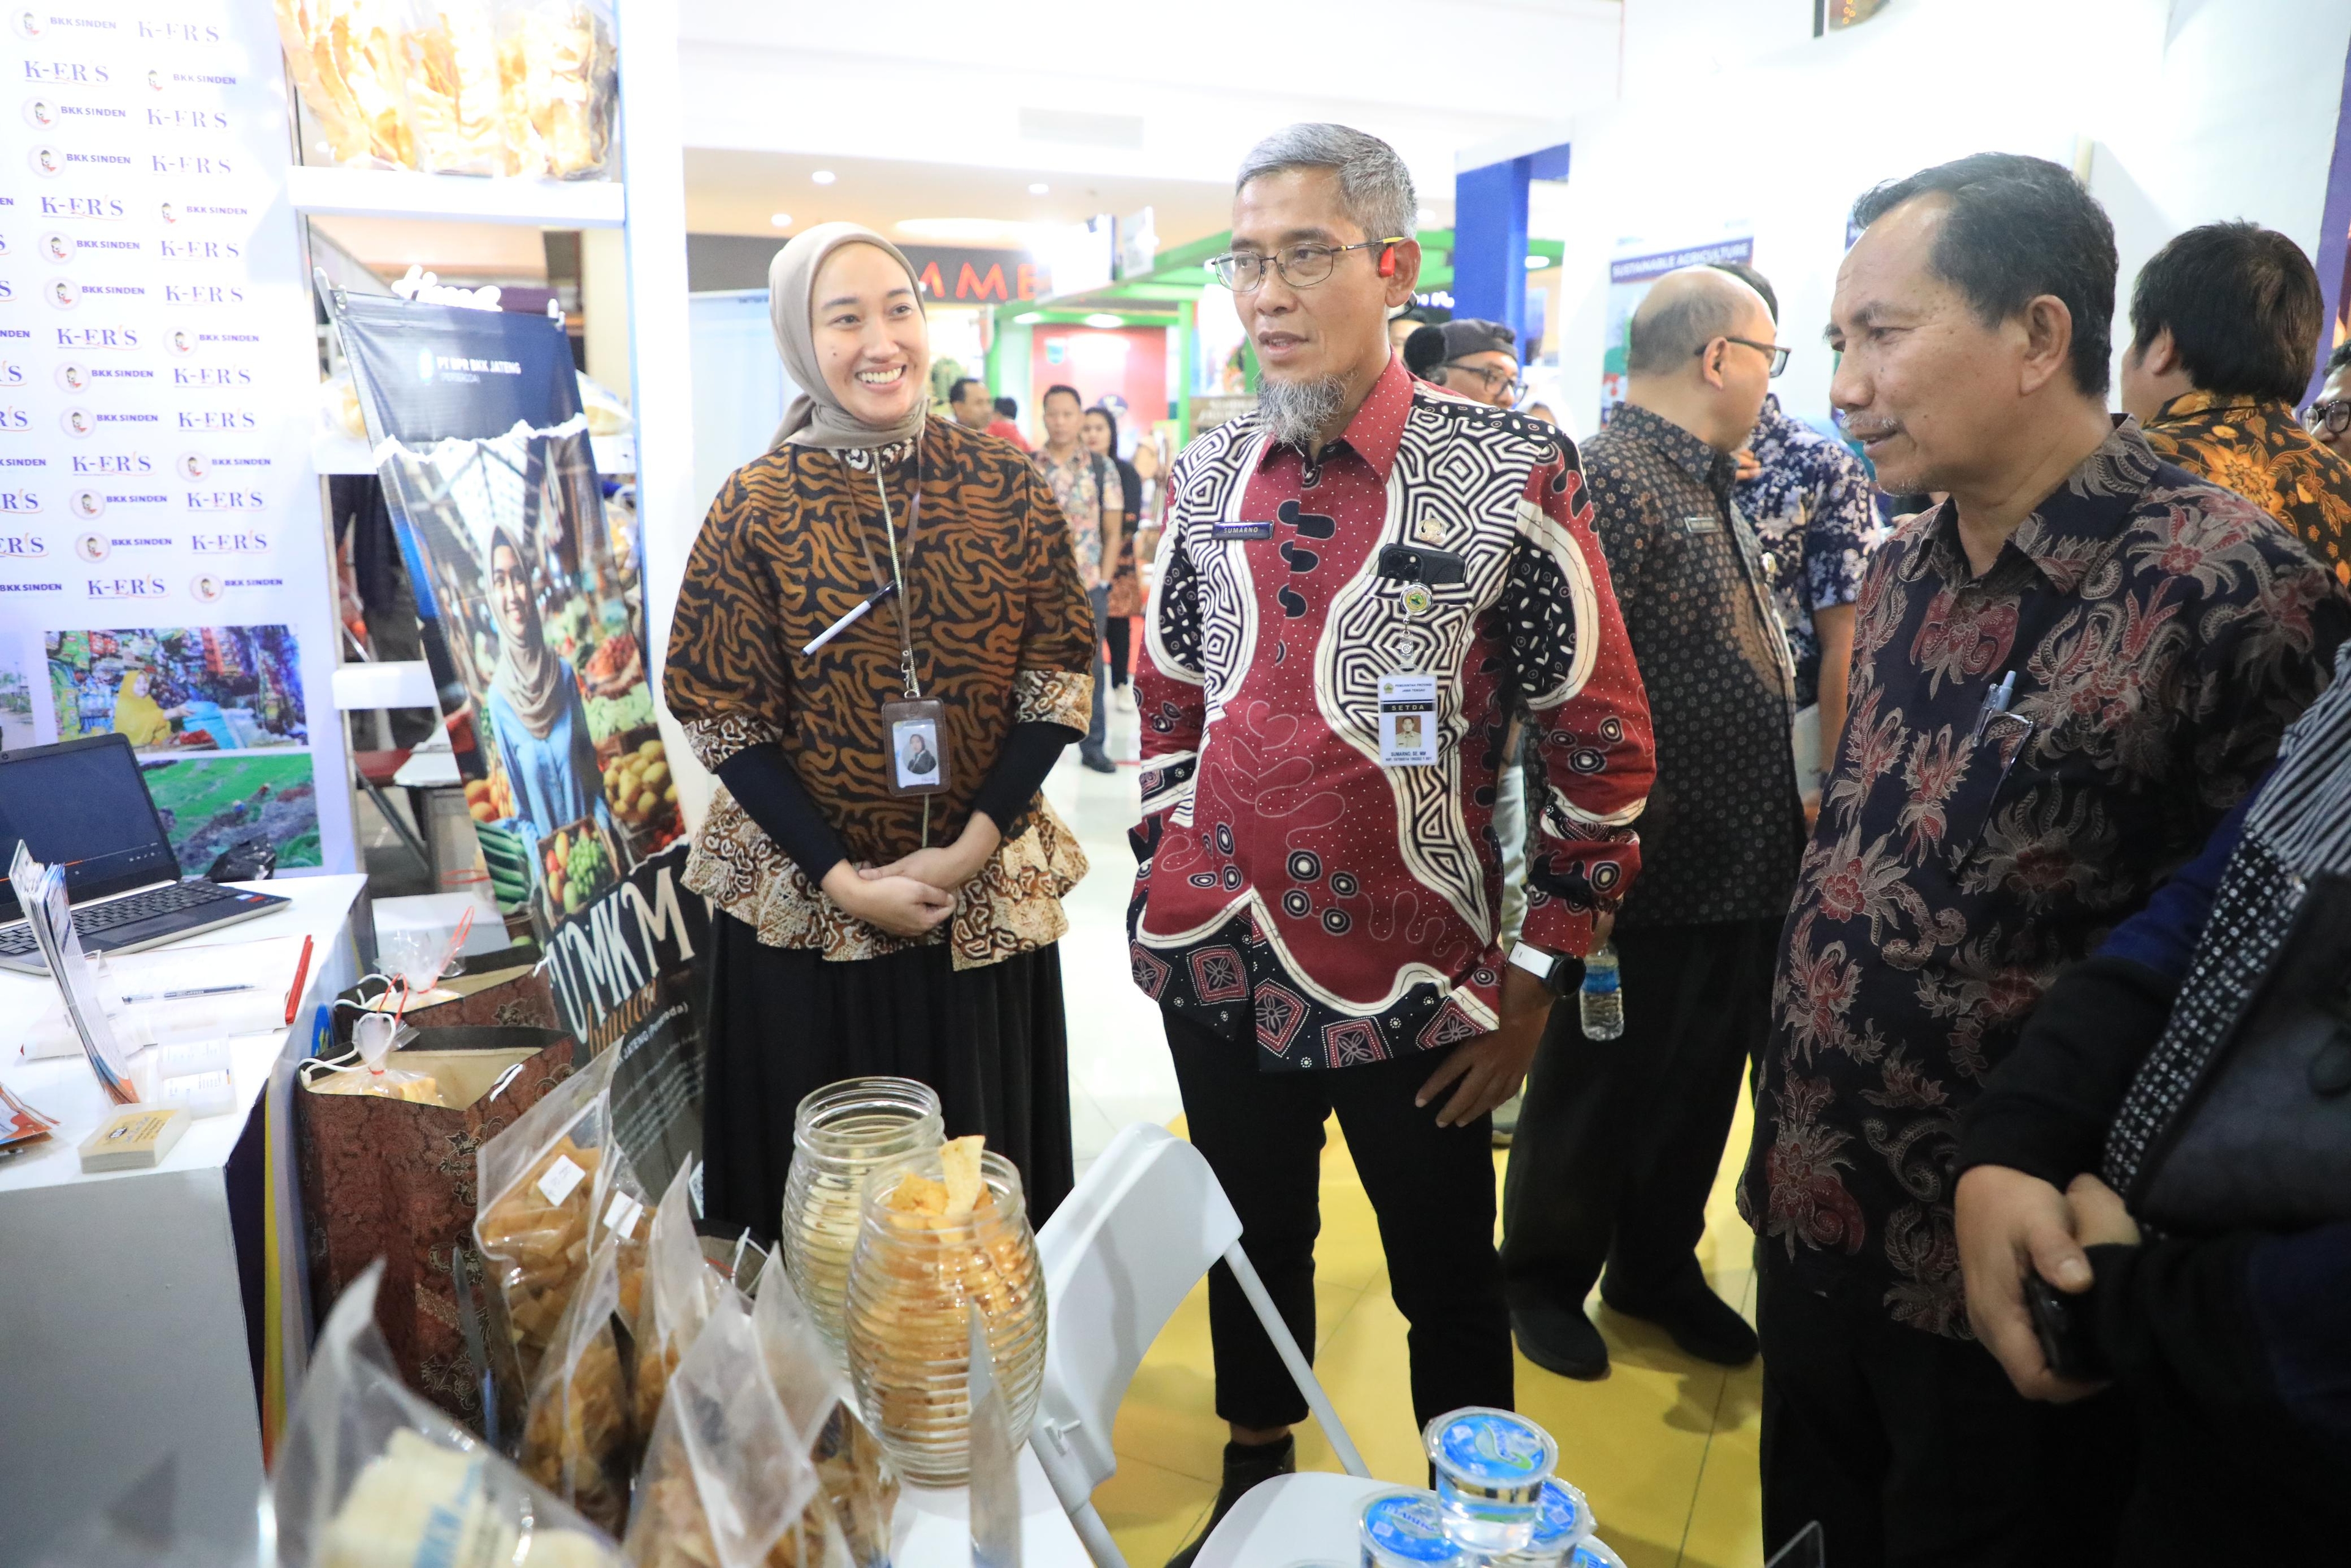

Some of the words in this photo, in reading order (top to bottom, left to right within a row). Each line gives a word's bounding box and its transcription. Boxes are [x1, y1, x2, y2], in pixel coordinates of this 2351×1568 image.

[50, 17, 73, 26] BKK
[75, 18, 116, 29] SINDEN
[173, 73, 195, 82] BKK
[197, 75, 236, 85] SINDEN
[61, 107, 83, 116] BKK
[85, 108, 126, 118] SINDEN
[66, 154, 89, 163] BKK
[91, 155, 131, 165] SINDEN
[77, 240, 99, 249] BKK
[100, 241, 140, 250] SINDEN
[105, 286, 145, 294] SINDEN
[222, 334, 259, 343] SINDEN
[114, 369, 153, 378] SINDEN
[119, 414, 158, 422] SINDEN
[6, 458, 47, 467] SINDEN
[22, 583, 63, 592] SINDEN
[545, 866, 696, 1045] UMKM
